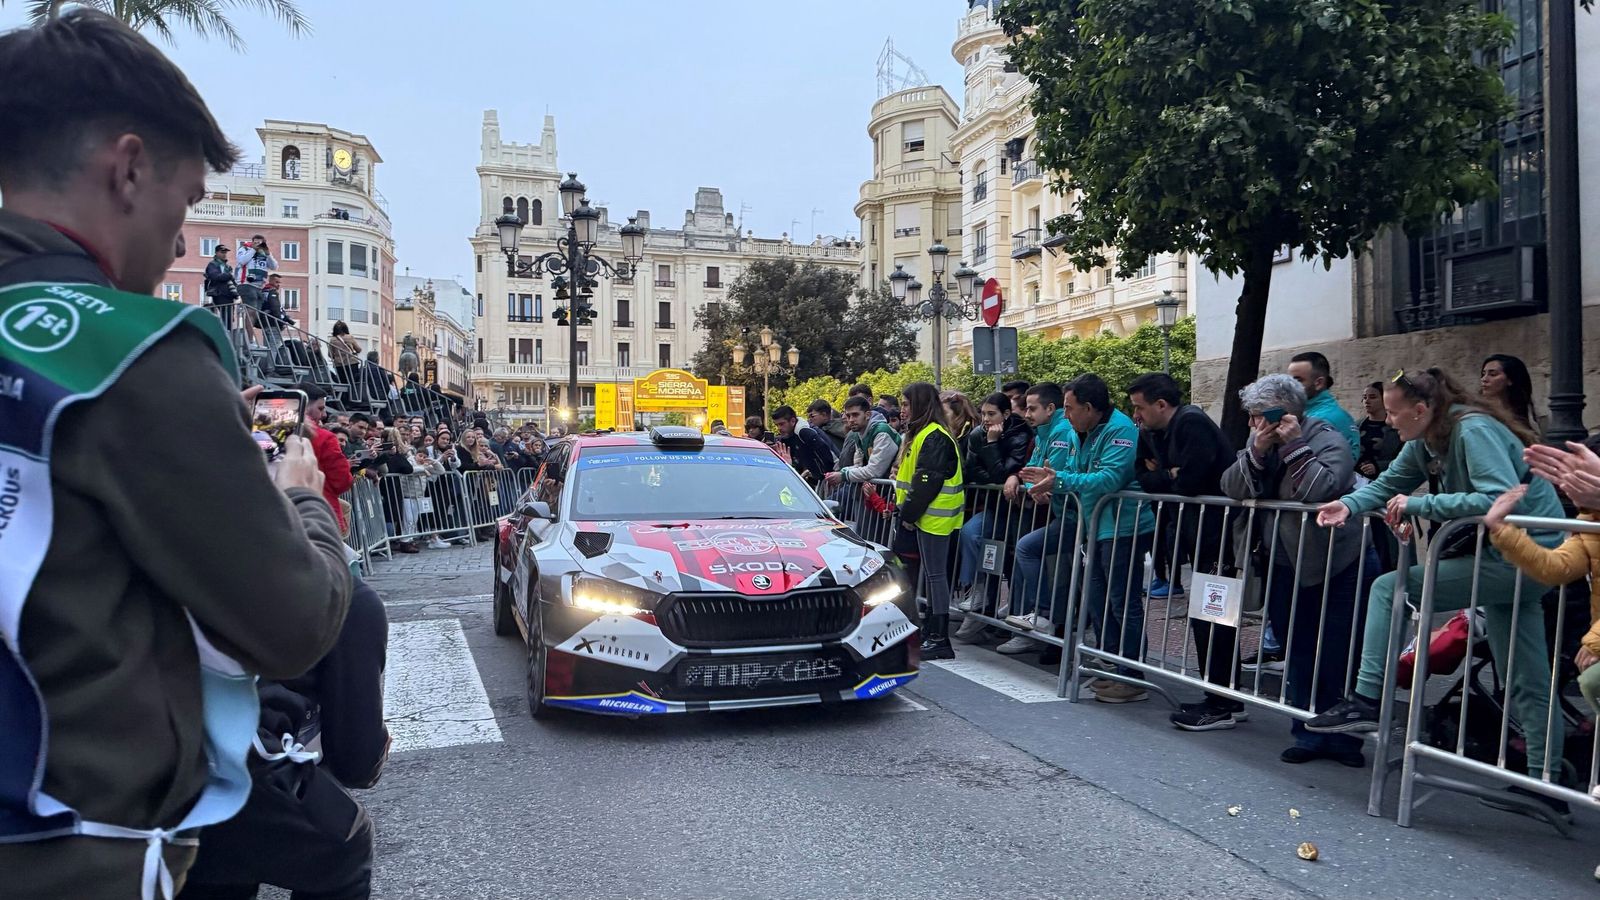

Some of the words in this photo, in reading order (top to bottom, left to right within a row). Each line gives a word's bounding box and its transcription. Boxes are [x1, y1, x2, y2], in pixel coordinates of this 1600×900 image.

[44, 286, 115, 314] SAFETY
[13, 305, 68, 336] 1st
[658, 381, 694, 389] SIERRA
[599, 644, 650, 662] MAKERON
[868, 678, 897, 696] MICHELIN
[599, 699, 654, 712] MICHELIN
